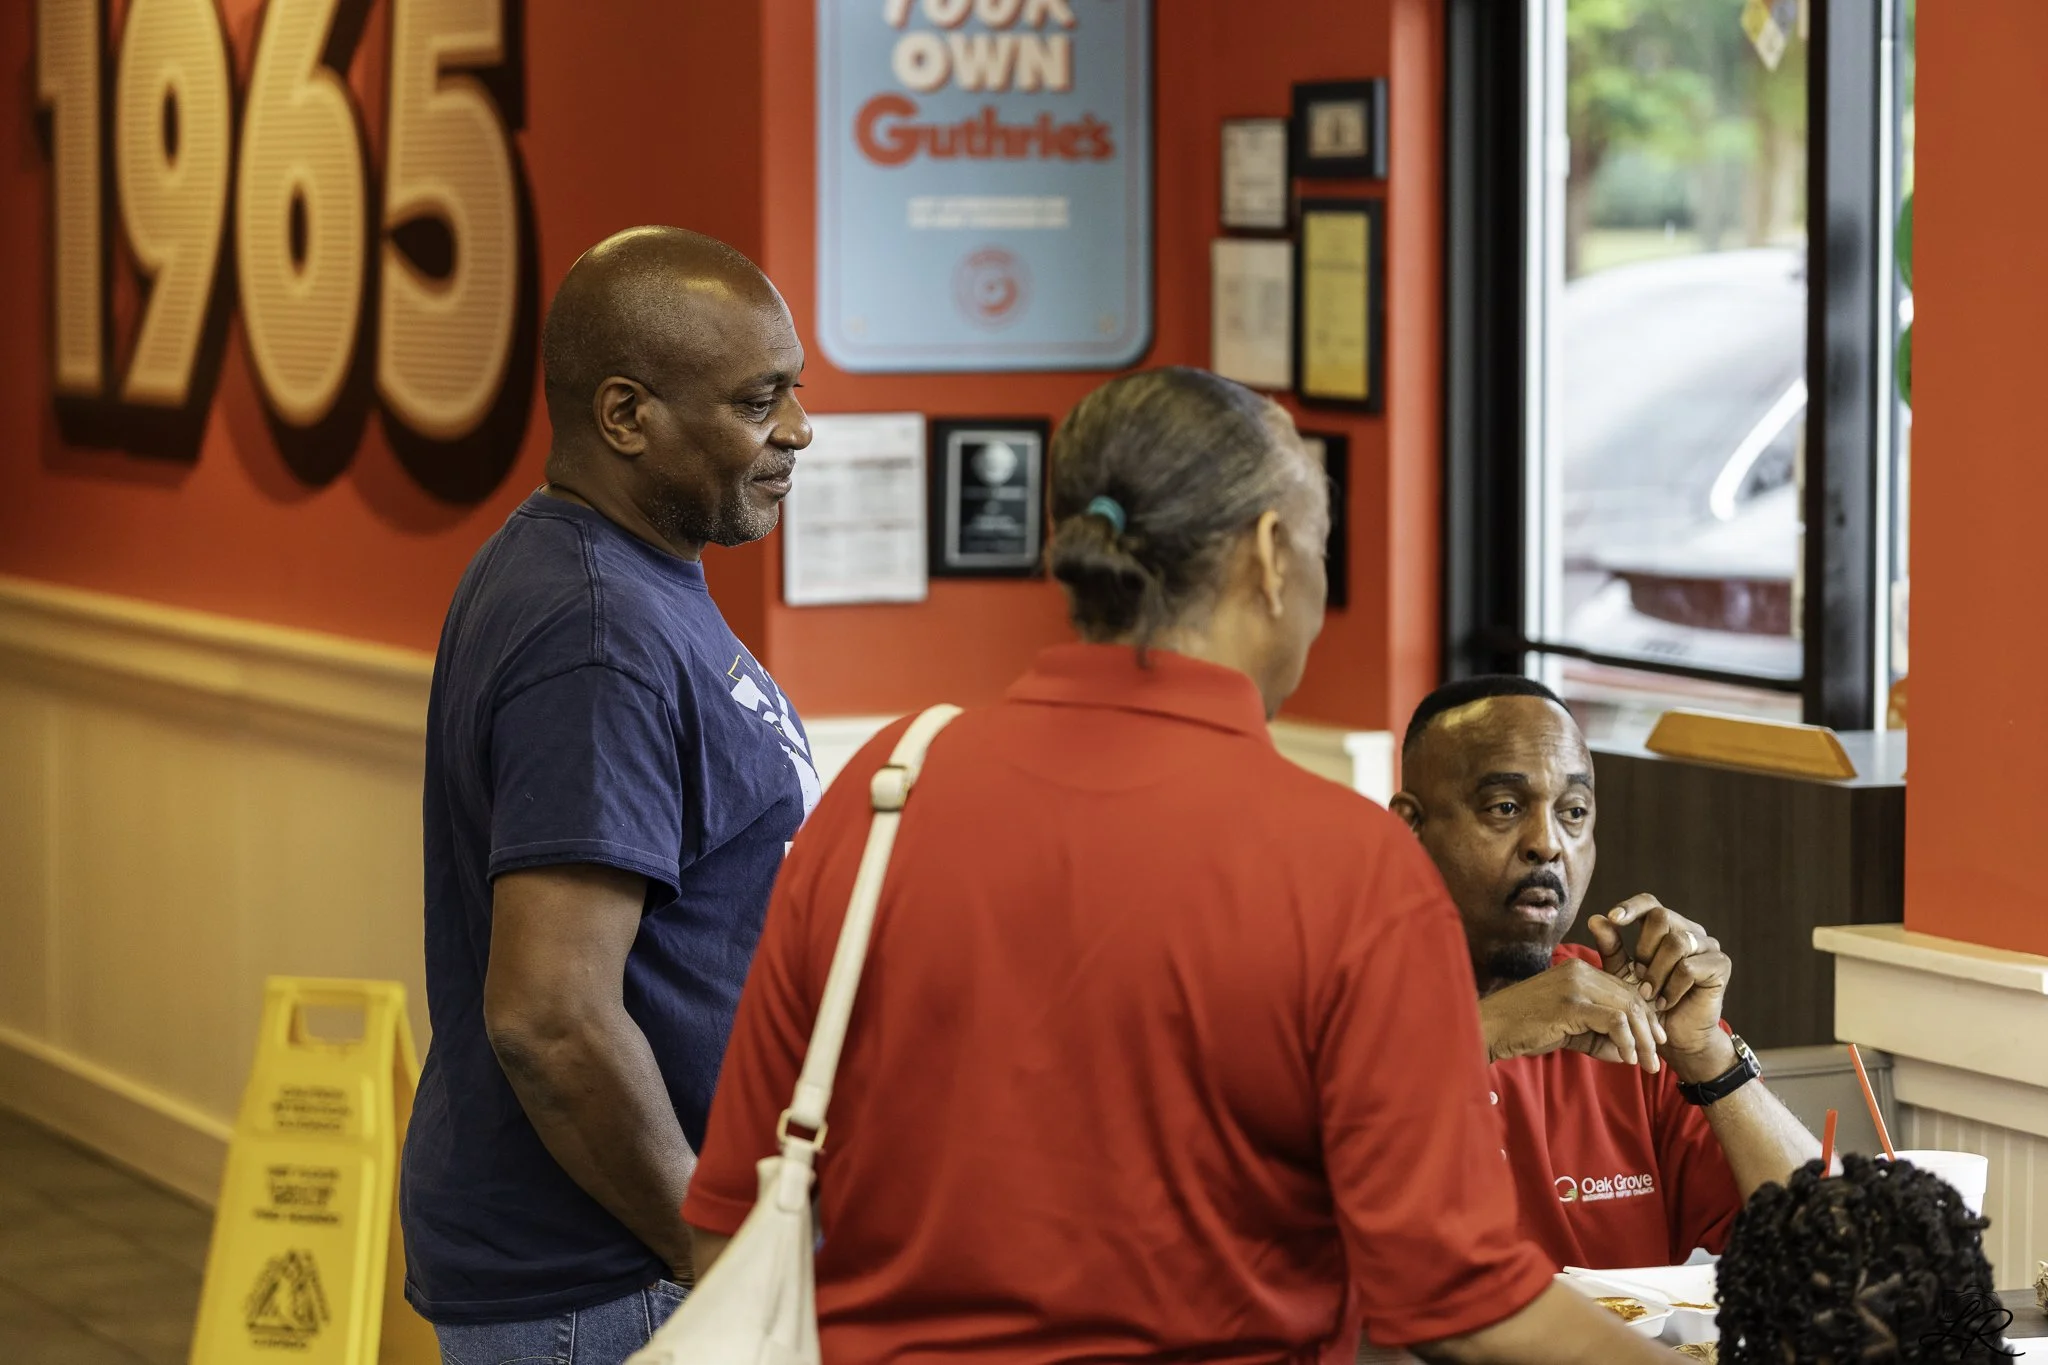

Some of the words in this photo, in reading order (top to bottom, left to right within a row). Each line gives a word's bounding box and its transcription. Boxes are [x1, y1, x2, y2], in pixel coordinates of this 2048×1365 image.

[892, 31, 1074, 93] OWN
[855, 94, 1114, 166] Guthrie's
[38, 0, 521, 442] 1965
[1581, 1177, 1613, 1194] Oak
[1614, 1173, 1653, 1190] Grove
